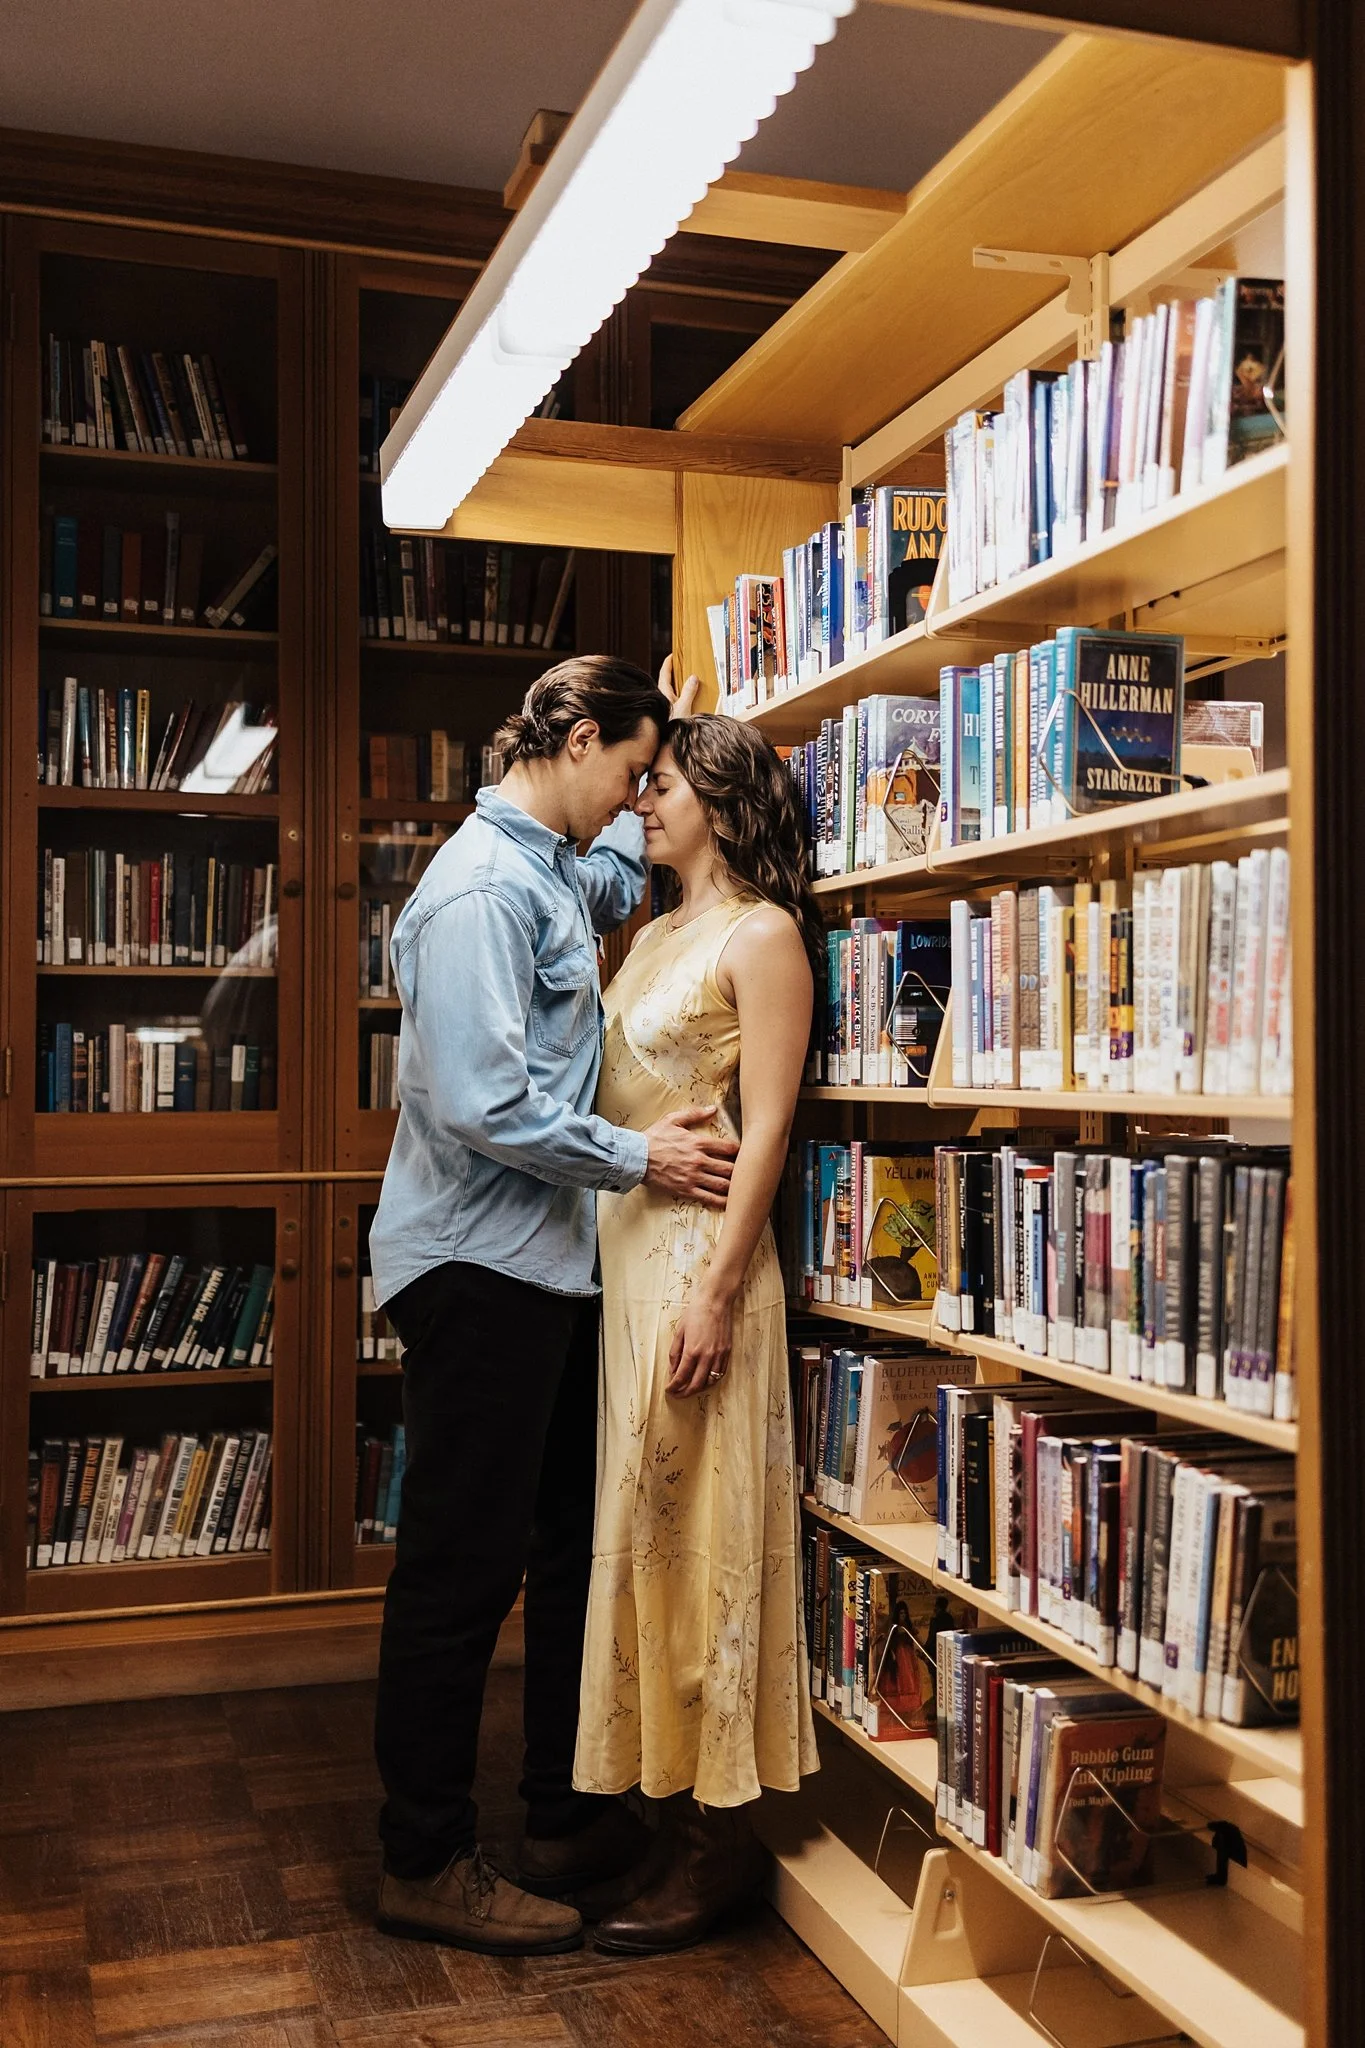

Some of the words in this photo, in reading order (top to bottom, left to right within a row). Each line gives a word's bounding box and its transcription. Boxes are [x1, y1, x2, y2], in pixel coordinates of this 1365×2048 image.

[1040, 660, 1048, 685] ANNE
[1056, 648, 1065, 673] ANNE
[1107, 654, 1150, 683] ANNE
[995, 669, 1003, 694] ANNE
[1080, 682, 1174, 715] HILLERMAN
[995, 695, 1003, 750] HILLERMAN
[1087, 767, 1162, 794] STARGAZER
[870, 1003, 876, 1012] By
[1075, 1187, 1084, 1227] Dream
[1075, 1230, 1084, 1278] Trekker
[200, 1270, 224, 1304] BANANA
[882, 1364, 972, 1378] BLUEFEATHER
[87, 1448, 100, 1465] TONY
[80, 1466, 97, 1505] HILLERMAN
[877, 1511, 906, 1520] MAX
[855, 1571, 864, 1620] BANANA
[1071, 1748, 1119, 1765] Bubble
[1122, 1747, 1154, 1762] Gum
[1102, 1767, 1154, 1787] Kipling
[1089, 1796, 1113, 1807] Maye
